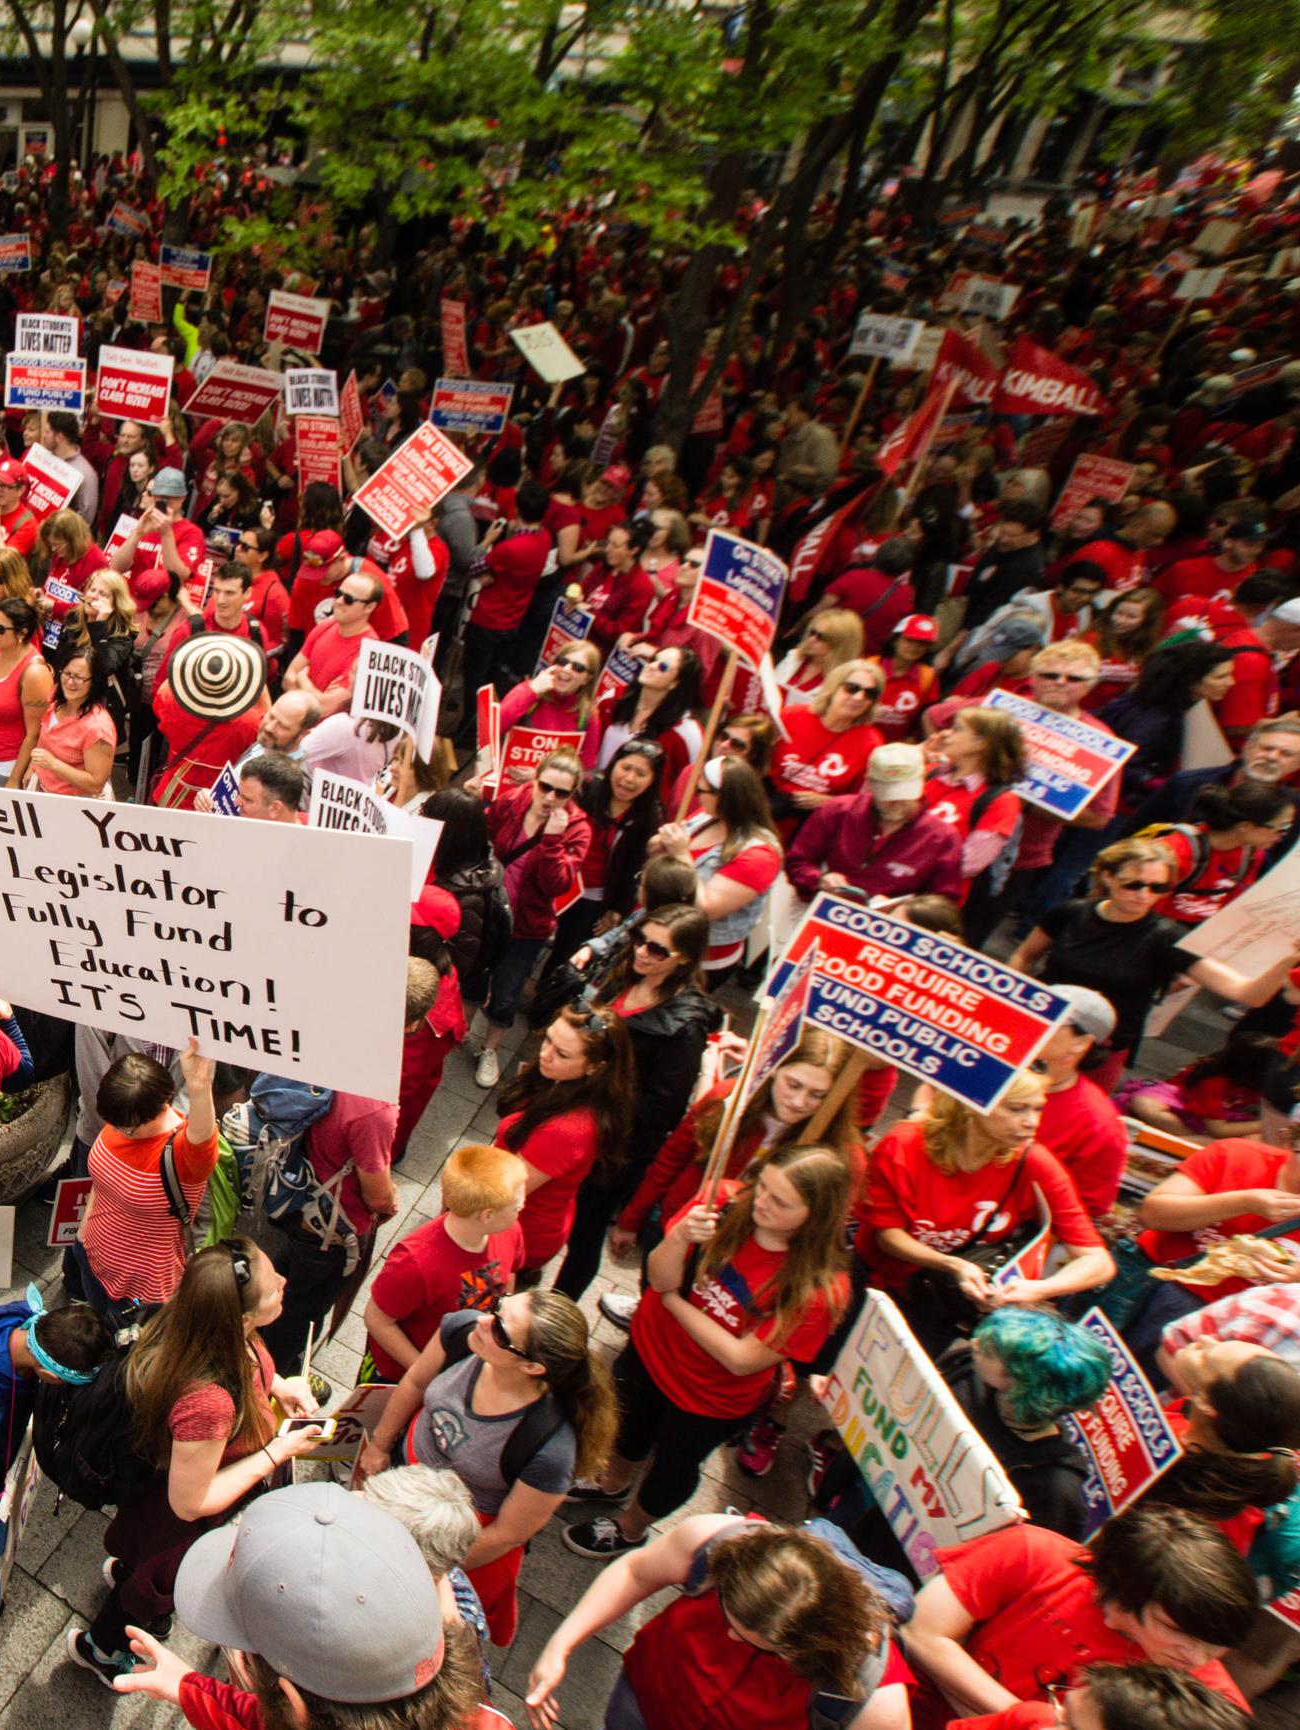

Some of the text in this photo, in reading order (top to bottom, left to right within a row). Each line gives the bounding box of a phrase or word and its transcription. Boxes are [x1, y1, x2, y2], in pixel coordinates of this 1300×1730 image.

[20, 332, 72, 354] LIVES MATTER
[21, 318, 72, 333] BLACK STUDENTS
[12, 357, 82, 370] GOOD SCHOOLS
[13, 378, 78, 390] GOOD FUNDING
[27, 369, 65, 379] REQUIRE
[17, 388, 73, 400] FUND PUBLIC
[25, 397, 65, 408] SCHOOLS
[100, 390, 125, 404] CLASS
[101, 375, 167, 398] DON'T INCREASE
[1001, 367, 1100, 415] KIMBALL
[403, 445, 450, 491] LEGISLATURE
[418, 428, 467, 476] ON STRIKE
[363, 494, 401, 531] SCHOOLS
[370, 486, 408, 522] FUNDING
[381, 483, 411, 511] START
[49, 583, 73, 601] GOOD
[368, 650, 407, 678] BLACK
[364, 674, 403, 719] LIVES
[531, 735, 560, 750] ON
[222, 773, 237, 794] On
[320, 779, 361, 810] BLACK
[82, 809, 197, 858] Your
[7, 847, 329, 928] Legislator to
[2, 893, 232, 952] Fully Fund
[49, 940, 277, 1012] Education!
[827, 905, 1052, 1012] GOOD SCHOOLS
[857, 946, 984, 1012] REQUIRE
[50, 979, 301, 1063] IT'S TIME!
[808, 977, 980, 1068] FUND PUBLIC
[811, 950, 1012, 1054] GOOD FUNDING
[814, 1004, 943, 1075] SCHOOLS
[1120, 1372, 1171, 1459] SCHOOLS
[852, 1365, 947, 1519] FUND MY
[1085, 1417, 1128, 1497] FUNDING
